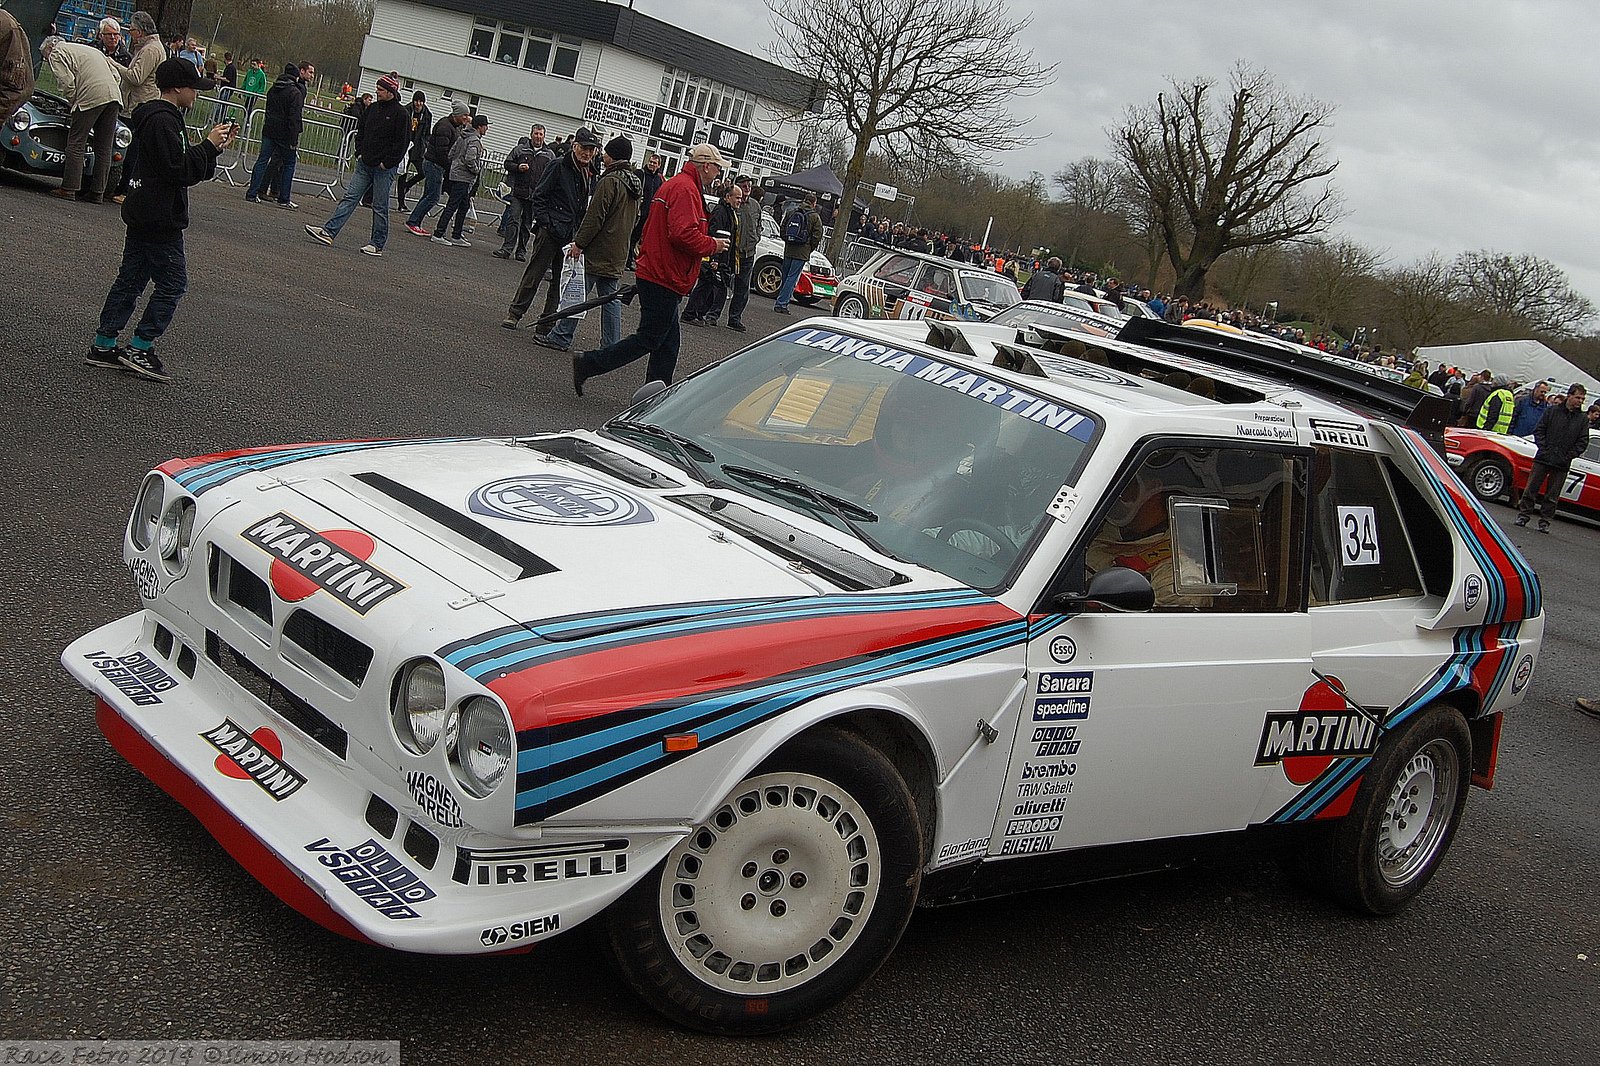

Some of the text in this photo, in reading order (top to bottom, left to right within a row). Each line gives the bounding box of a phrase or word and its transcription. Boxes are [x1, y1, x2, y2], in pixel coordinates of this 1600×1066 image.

[589, 88, 606, 102] LOCAL
[607, 93, 632, 109] PRODUCE
[585, 107, 602, 122] EGGS
[661, 113, 687, 137] FARM
[719, 130, 739, 150] SHOP
[44, 151, 66, 163] 759
[1020, 303, 1063, 316] ANDREWS
[1088, 319, 1103, 329] for
[796, 329, 909, 372] LANCIA
[915, 360, 1086, 433] MARTINI
[1273, 426, 1293, 439] Sport
[1309, 417, 1369, 448] PIRELLI
[1344, 513, 1377, 561] 34
[249, 516, 394, 607] MARTINI
[1053, 643, 1073, 655] Esso
[121, 652, 176, 691] OLIO
[103, 669, 161, 704] FIAT
[1040, 674, 1090, 692] Savara
[1036, 699, 1087, 719] speedline
[1033, 727, 1075, 741] OLIO
[1263, 714, 1379, 757] MARTINI
[1038, 742, 1080, 755] FIAT
[207, 723, 299, 797] MARTINI
[1021, 760, 1077, 779] brembo
[406, 771, 461, 819] MAGNETI
[1017, 781, 1074, 798] TRW Sabelt
[1013, 798, 1066, 816] olivetti
[1007, 817, 1060, 835] FERODO
[939, 838, 990, 858] Giordano
[1001, 835, 1054, 855] BILSTEIN
[351, 842, 432, 901] OLIO
[451, 838, 630, 886] PIRELLI
[335, 867, 416, 917] FIAT
[510, 913, 560, 940] SIEM
